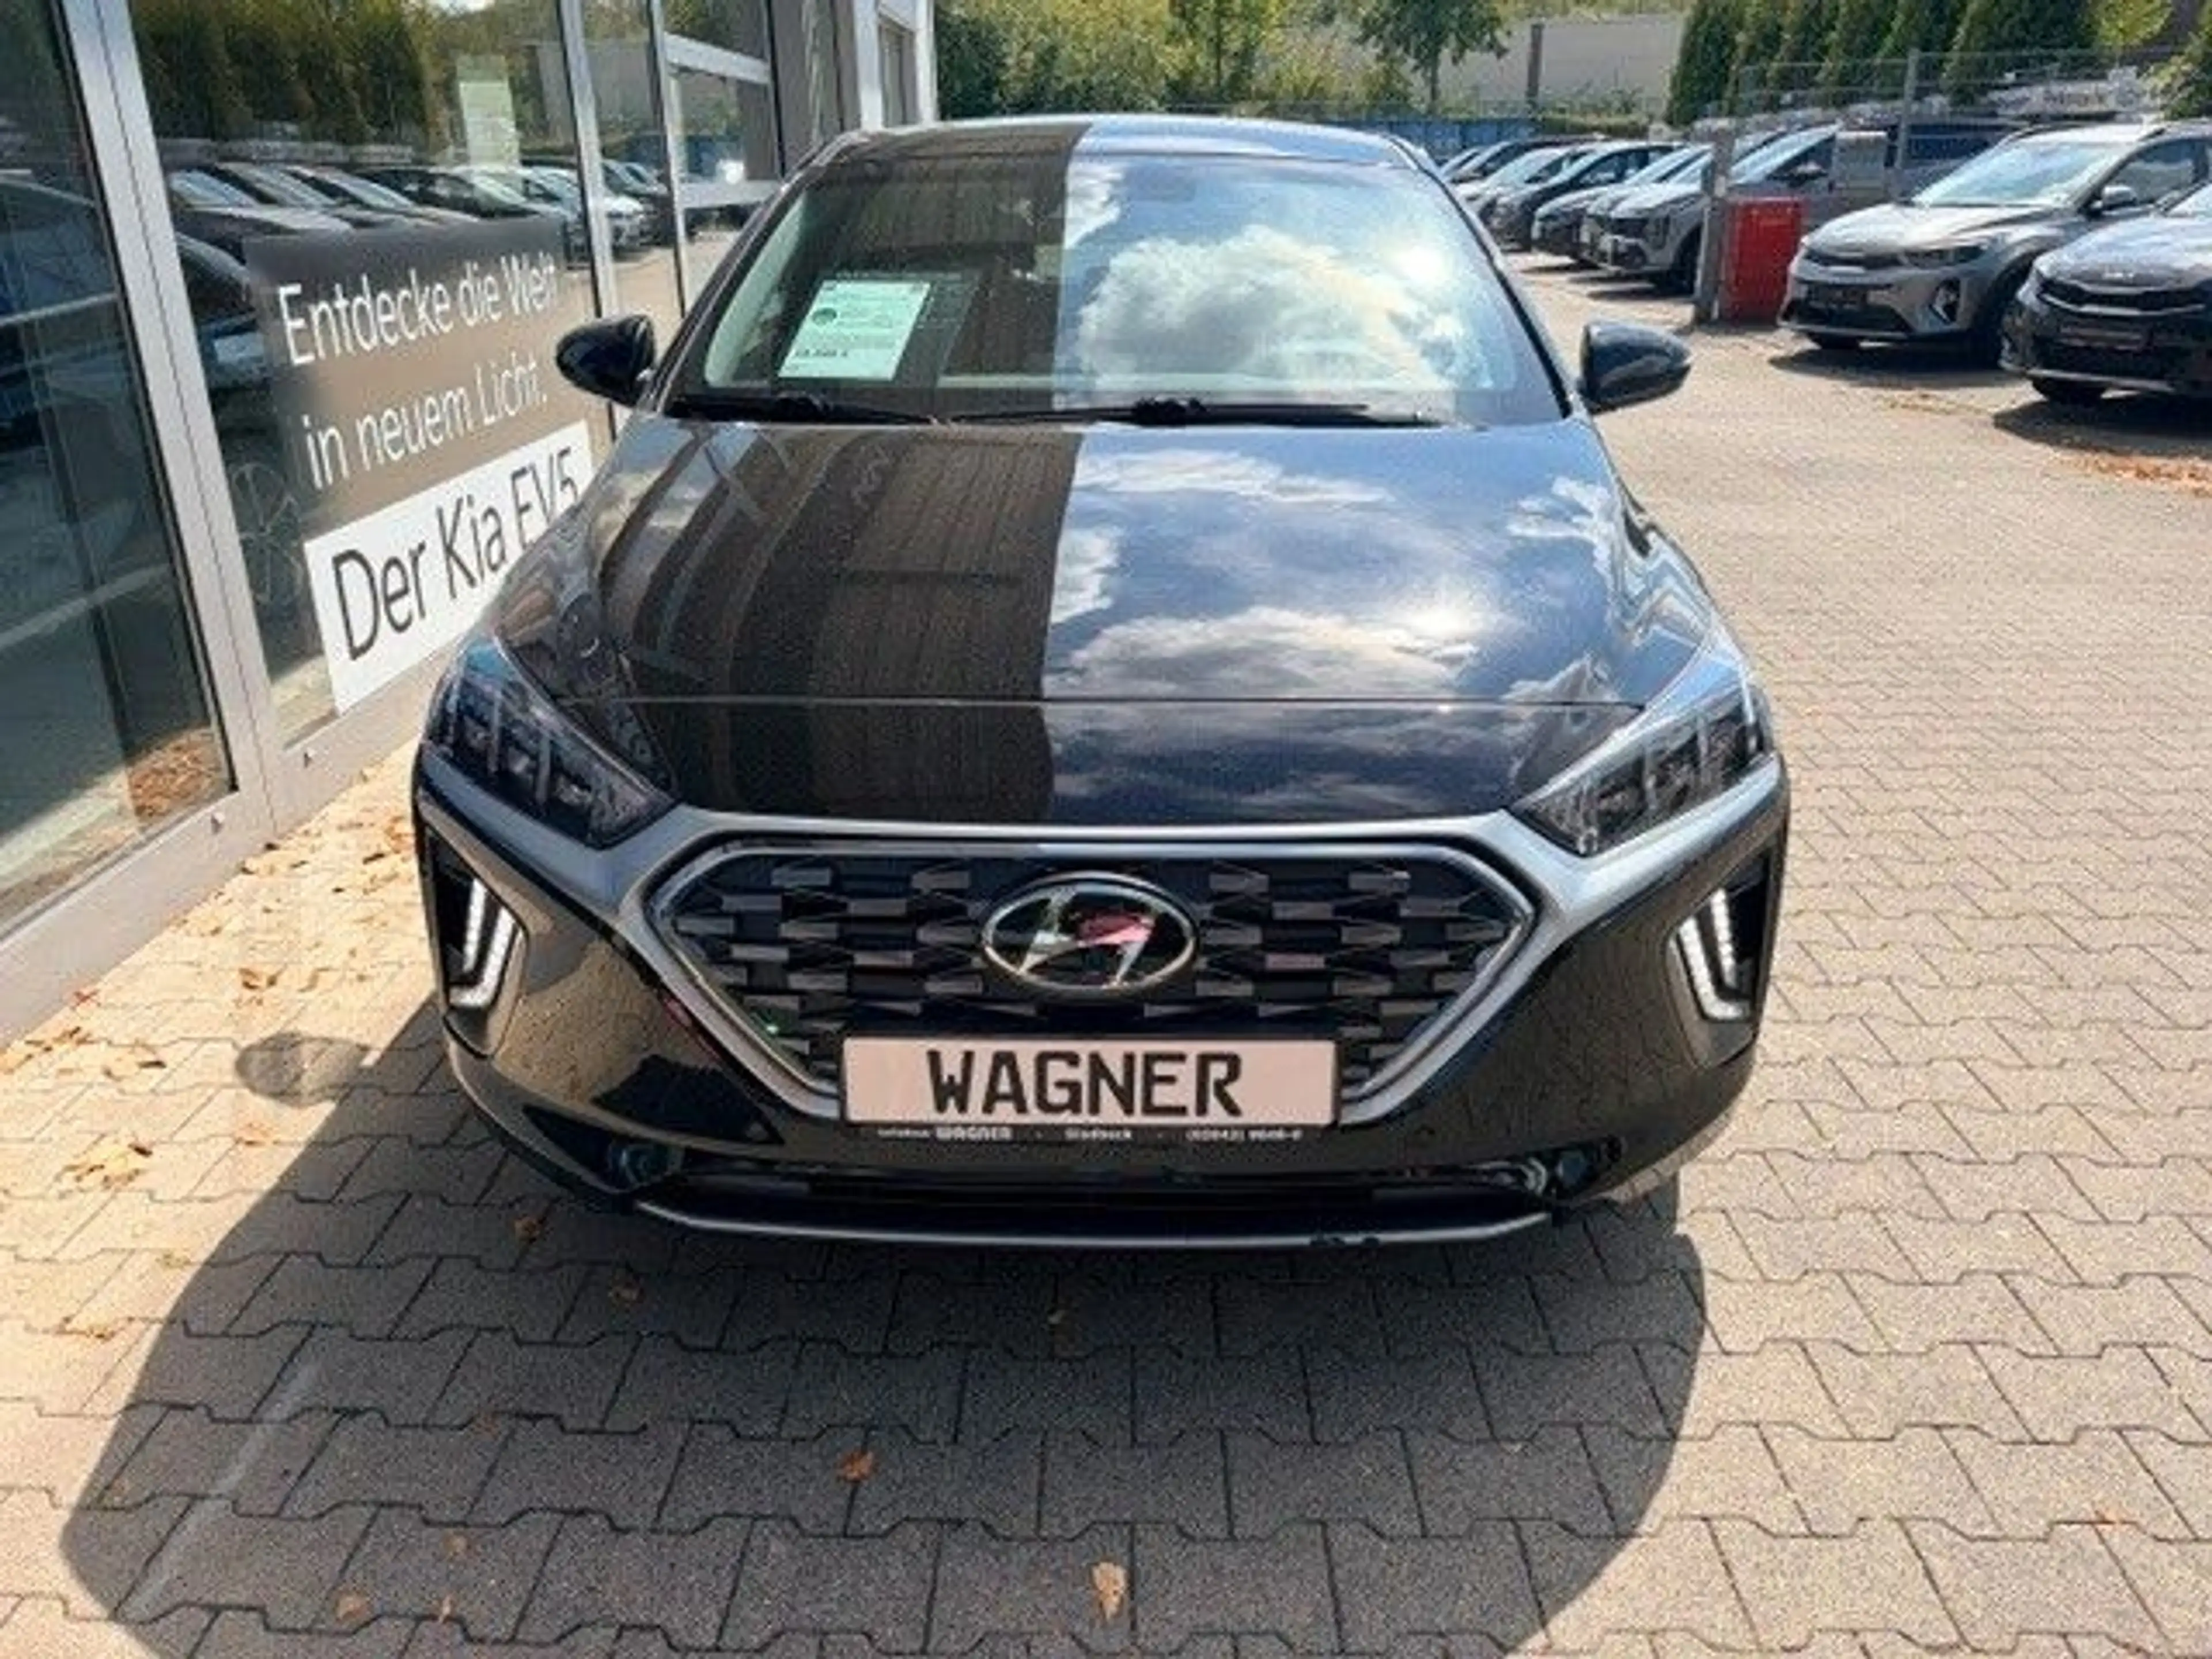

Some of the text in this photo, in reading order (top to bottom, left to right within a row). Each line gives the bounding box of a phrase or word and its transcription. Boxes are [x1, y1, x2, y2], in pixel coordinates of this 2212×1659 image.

[279, 251, 556, 366] Entdecke die Welt
[302, 351, 547, 490] in neuem Licht.
[332, 446, 579, 661] Der Kia EV5
[926, 1050, 1243, 1118] WAGNER
